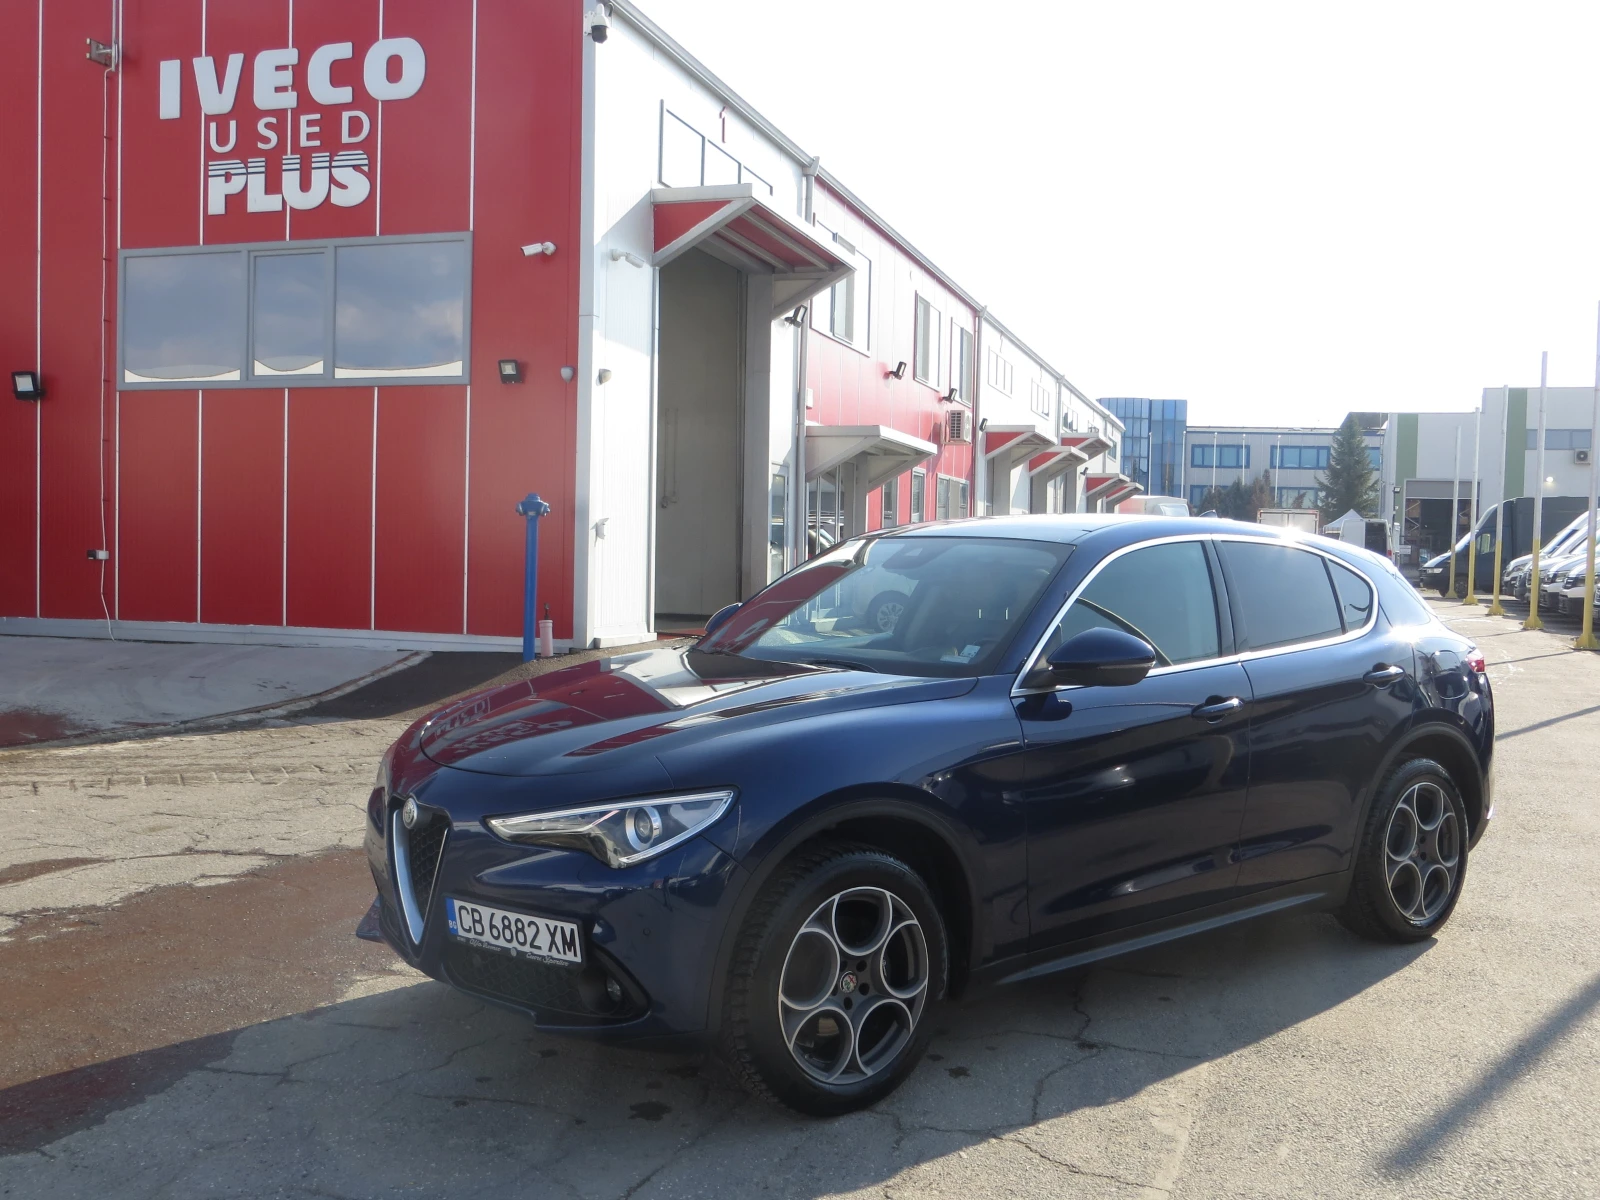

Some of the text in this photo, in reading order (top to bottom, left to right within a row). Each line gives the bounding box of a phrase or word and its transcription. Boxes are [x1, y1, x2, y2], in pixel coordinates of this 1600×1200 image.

[159, 37, 426, 120] IVECO
[209, 110, 371, 154] USED
[207, 150, 371, 216] PLUS
